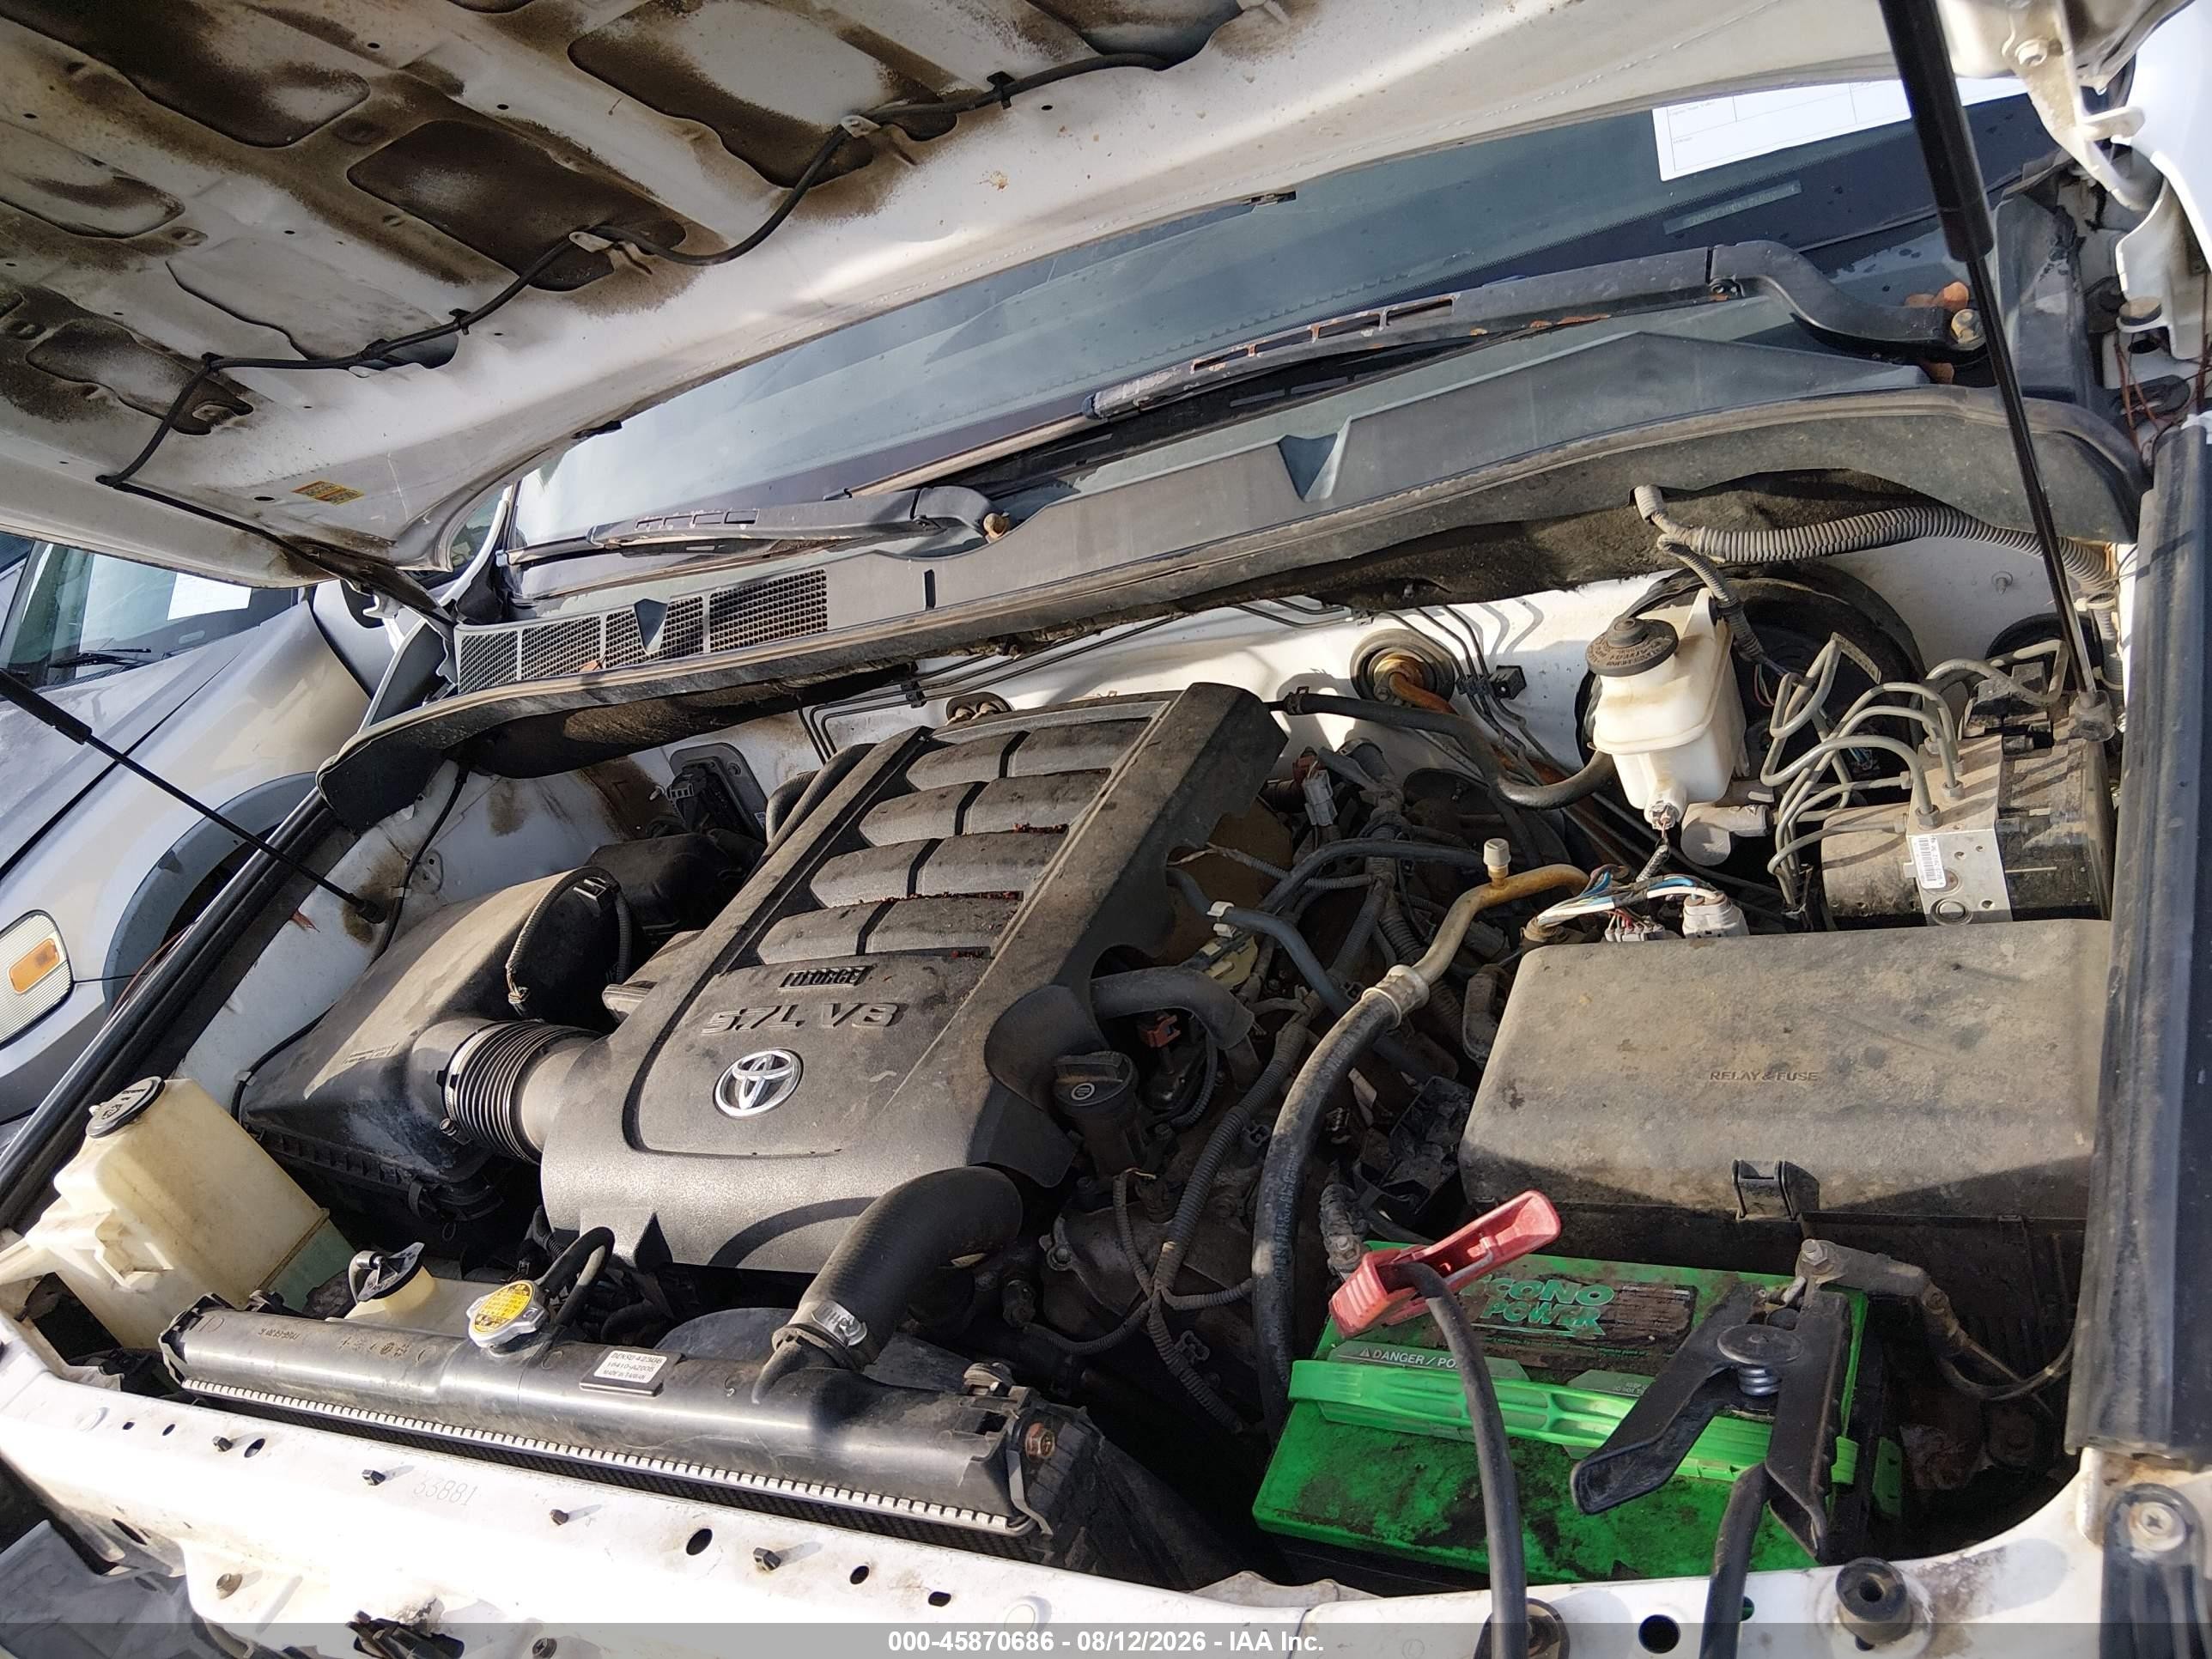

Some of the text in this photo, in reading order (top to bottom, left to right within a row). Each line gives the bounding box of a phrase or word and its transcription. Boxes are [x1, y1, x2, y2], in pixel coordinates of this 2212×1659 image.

[701, 1002, 906, 1034] 5.7L V8
[1709, 1070, 1760, 1082] RELAY
[1775, 1071, 1820, 1082] FUSE
[1480, 1297, 1607, 1337] POWER
[1374, 1349, 1423, 1365] DANGER
